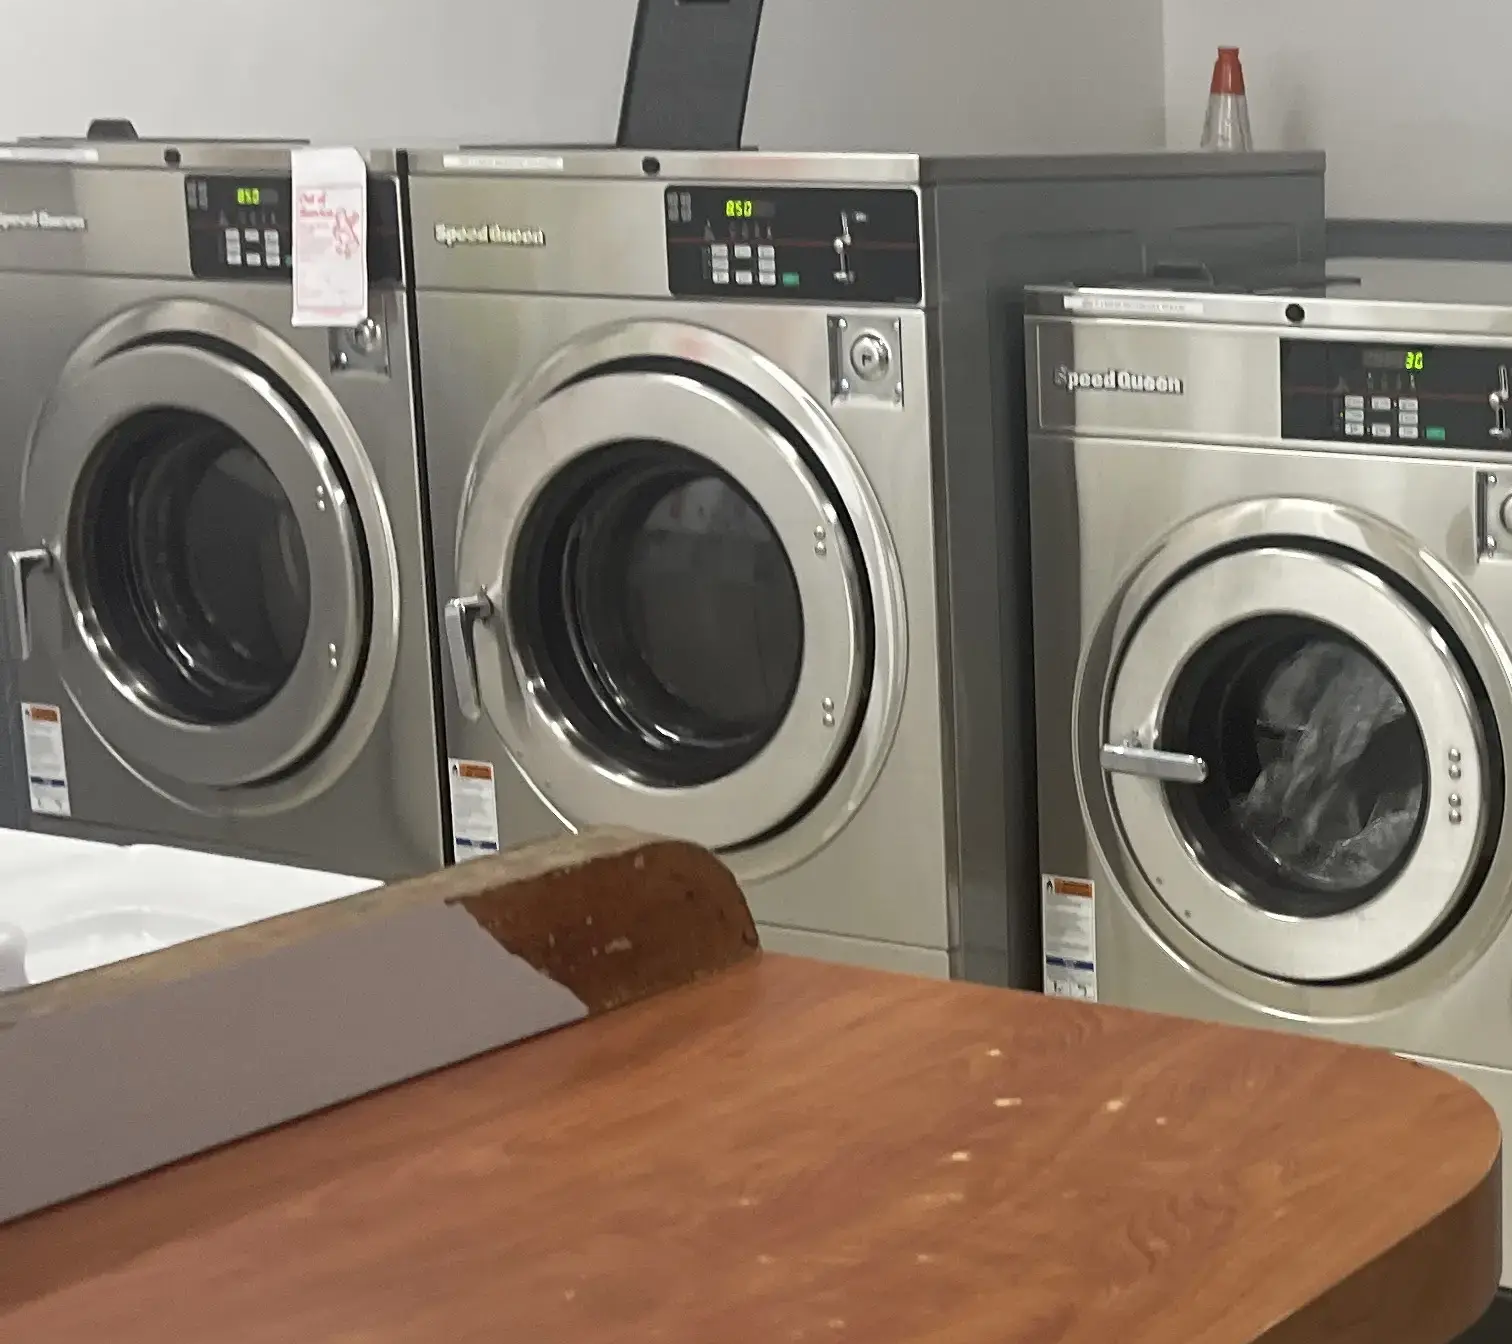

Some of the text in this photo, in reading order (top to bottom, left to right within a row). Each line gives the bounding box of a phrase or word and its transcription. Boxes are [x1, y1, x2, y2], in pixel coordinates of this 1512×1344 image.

[1405, 351, 1424, 370] 30
[1053, 364, 1181, 394] Speed Queen
